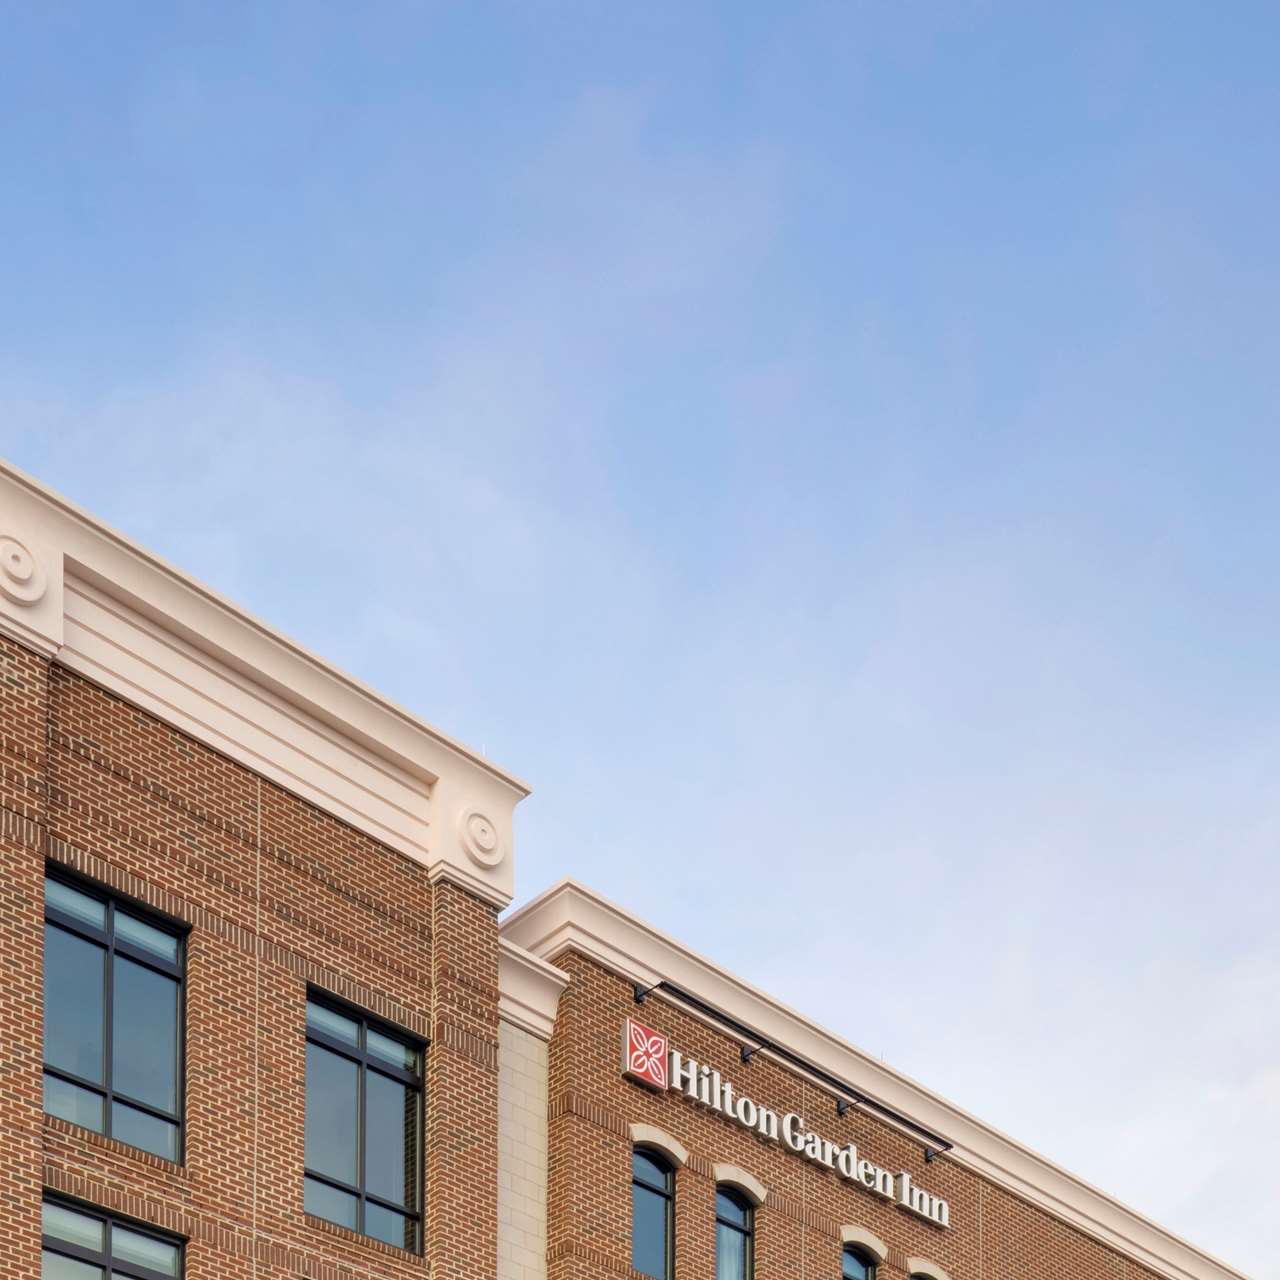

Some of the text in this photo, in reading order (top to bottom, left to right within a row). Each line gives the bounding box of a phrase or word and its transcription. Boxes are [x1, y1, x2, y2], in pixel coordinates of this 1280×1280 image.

[670, 1050, 950, 1228] Hilton Garden Inn
